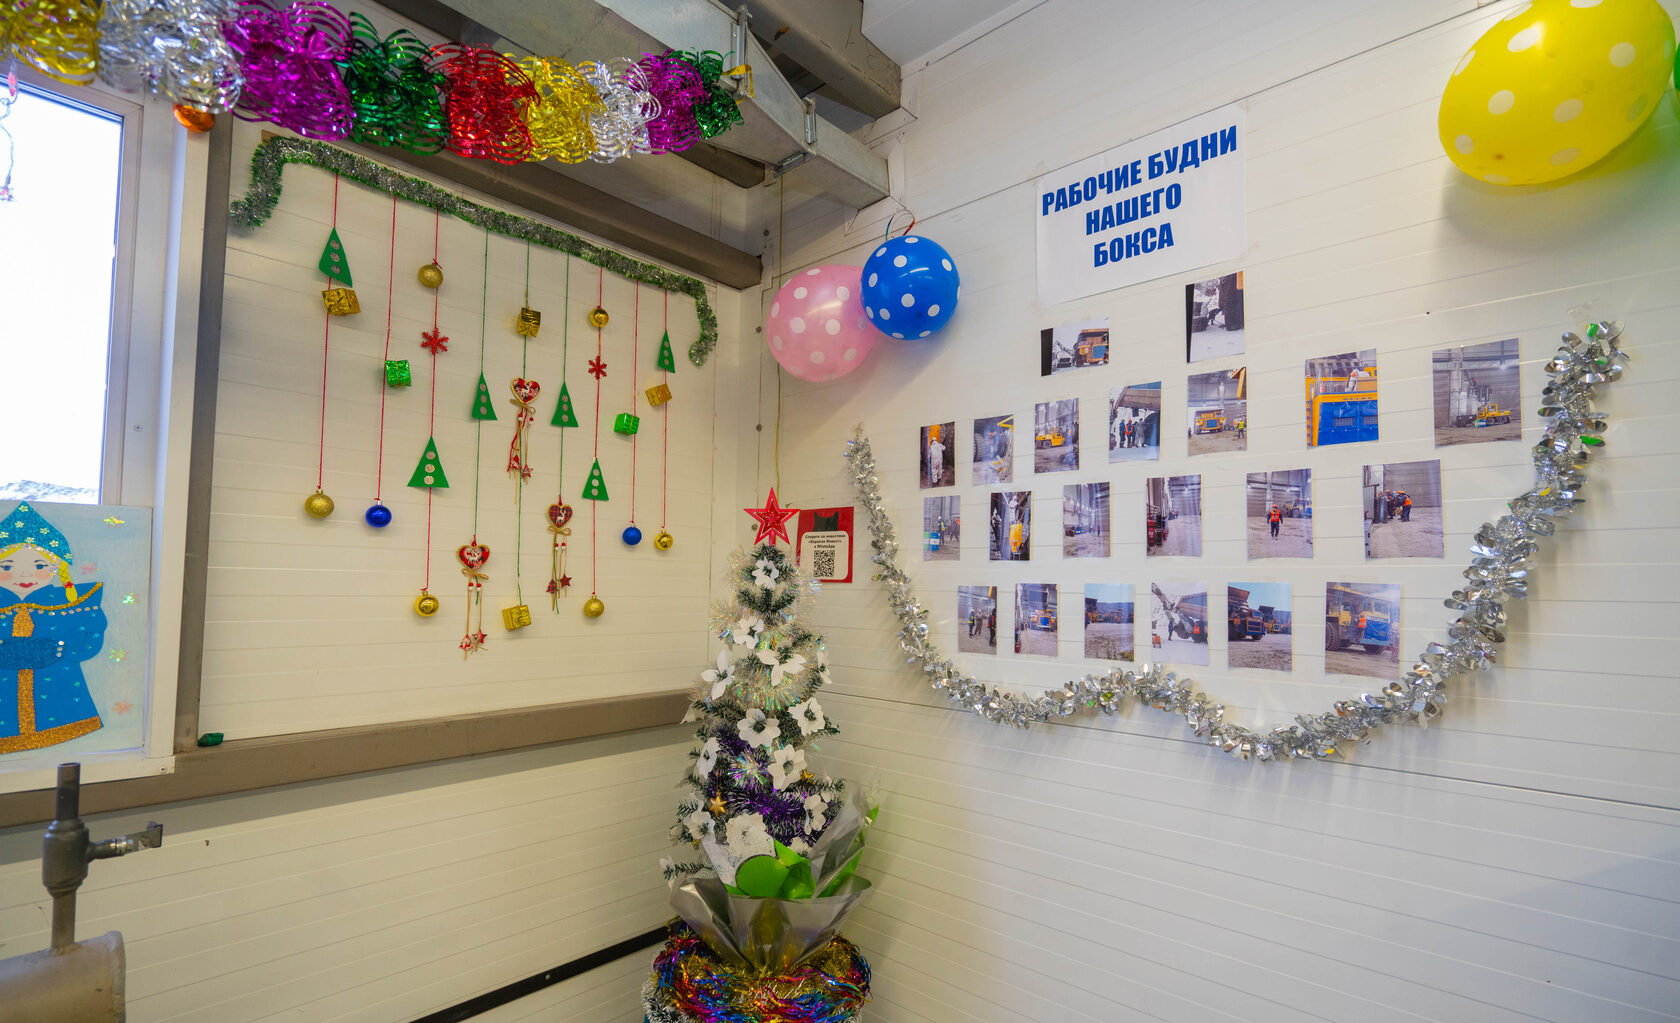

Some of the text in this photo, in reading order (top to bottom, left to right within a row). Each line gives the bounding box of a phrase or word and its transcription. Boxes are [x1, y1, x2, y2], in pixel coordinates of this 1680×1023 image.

[1042, 125, 1237, 216] РАБОЧИЕ БУДНИ
[1086, 183, 1182, 236] НАШЕГО
[1093, 222, 1175, 268] БОКСА
